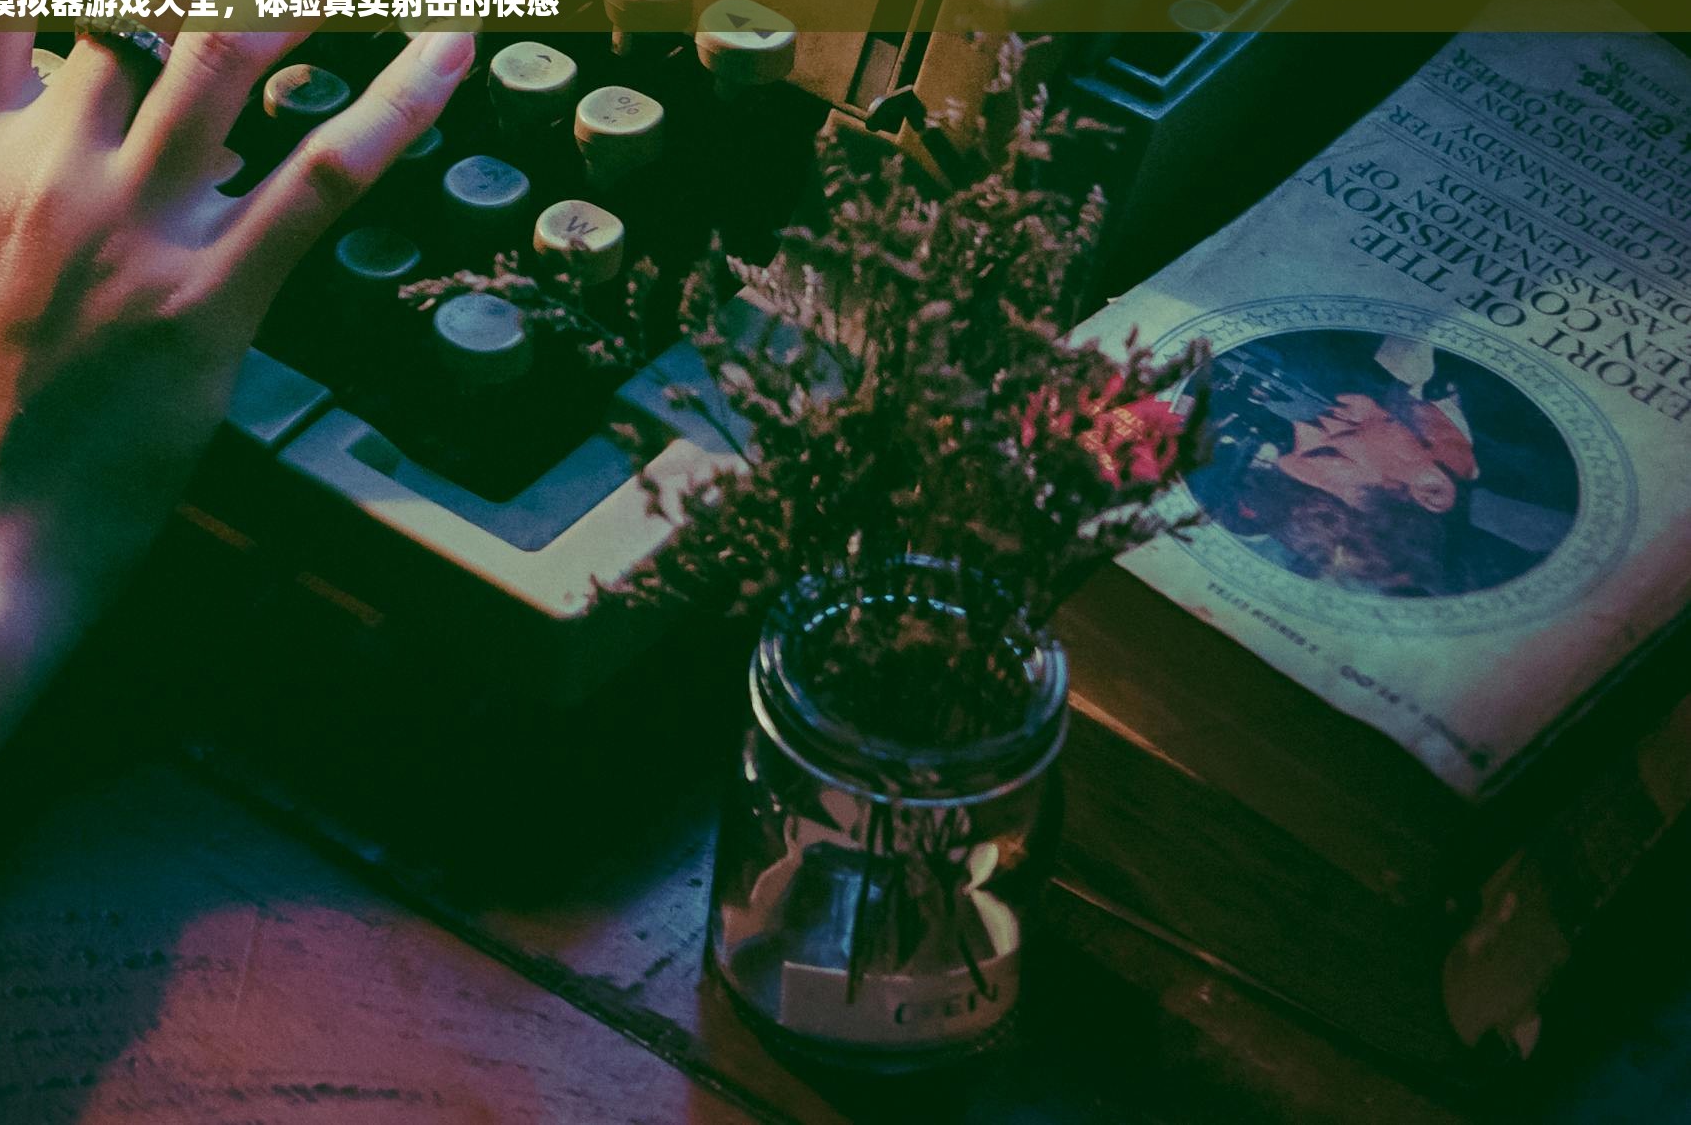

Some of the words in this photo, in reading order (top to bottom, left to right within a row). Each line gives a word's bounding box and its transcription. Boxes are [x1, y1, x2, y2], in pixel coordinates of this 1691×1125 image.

[1429, 67, 1474, 94] BY
[1451, 46, 1546, 111] OTHER
[1541, 89, 1588, 115] BY
[1387, 103, 1517, 182] ANSWER
[1451, 123, 1598, 208] KENNEDY
[1550, 117, 1609, 152] AND
[1347, 159, 1398, 187] OF
[1304, 165, 1601, 329] COMMISSION
[1424, 173, 1596, 268] KENNEDY
[1522, 182, 1650, 257] OFFICIAL
[1348, 224, 1454, 292] THE
[1403, 189, 1675, 336] ASSASSINATION
[1454, 287, 1525, 323] OF
